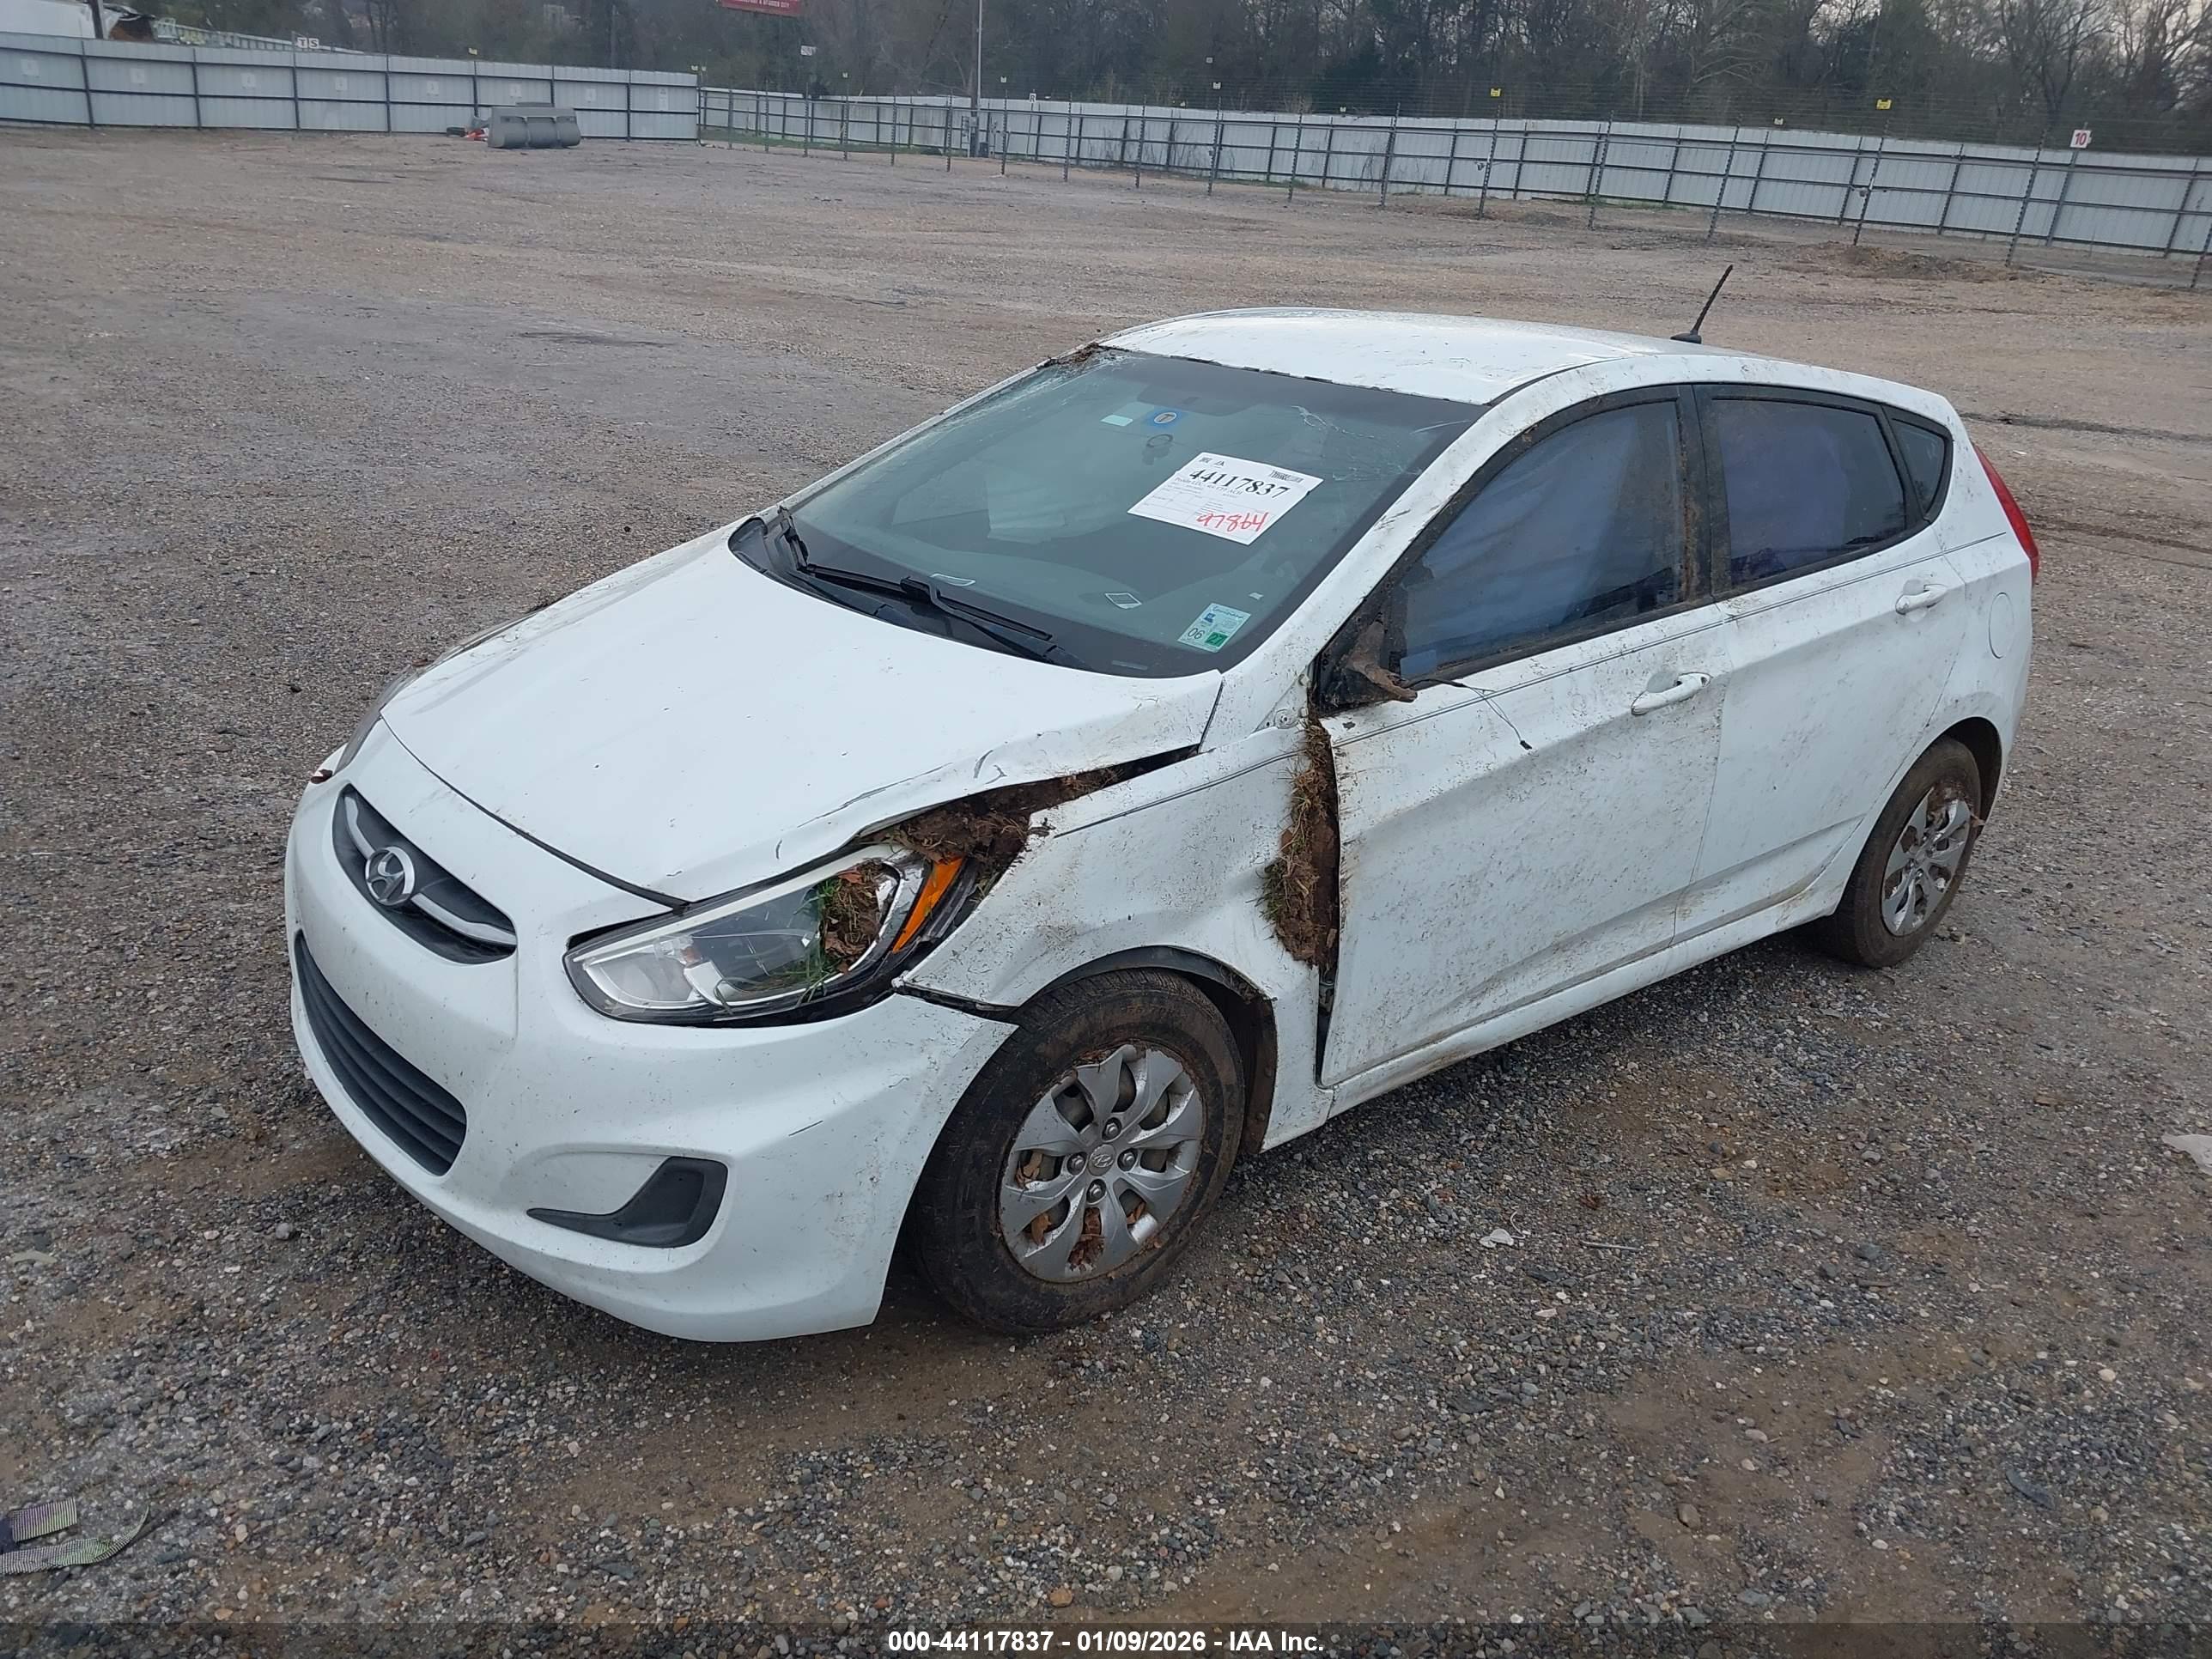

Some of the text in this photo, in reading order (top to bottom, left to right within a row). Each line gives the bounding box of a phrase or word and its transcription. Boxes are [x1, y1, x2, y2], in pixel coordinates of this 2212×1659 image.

[310, 40, 318, 48] S
[1030, 94, 1036, 103] R
[2074, 132, 2087, 146] 10
[1188, 469, 1291, 499] 44117837
[1195, 512, 1269, 532] 97864
[1188, 628, 1225, 646] 06 27
